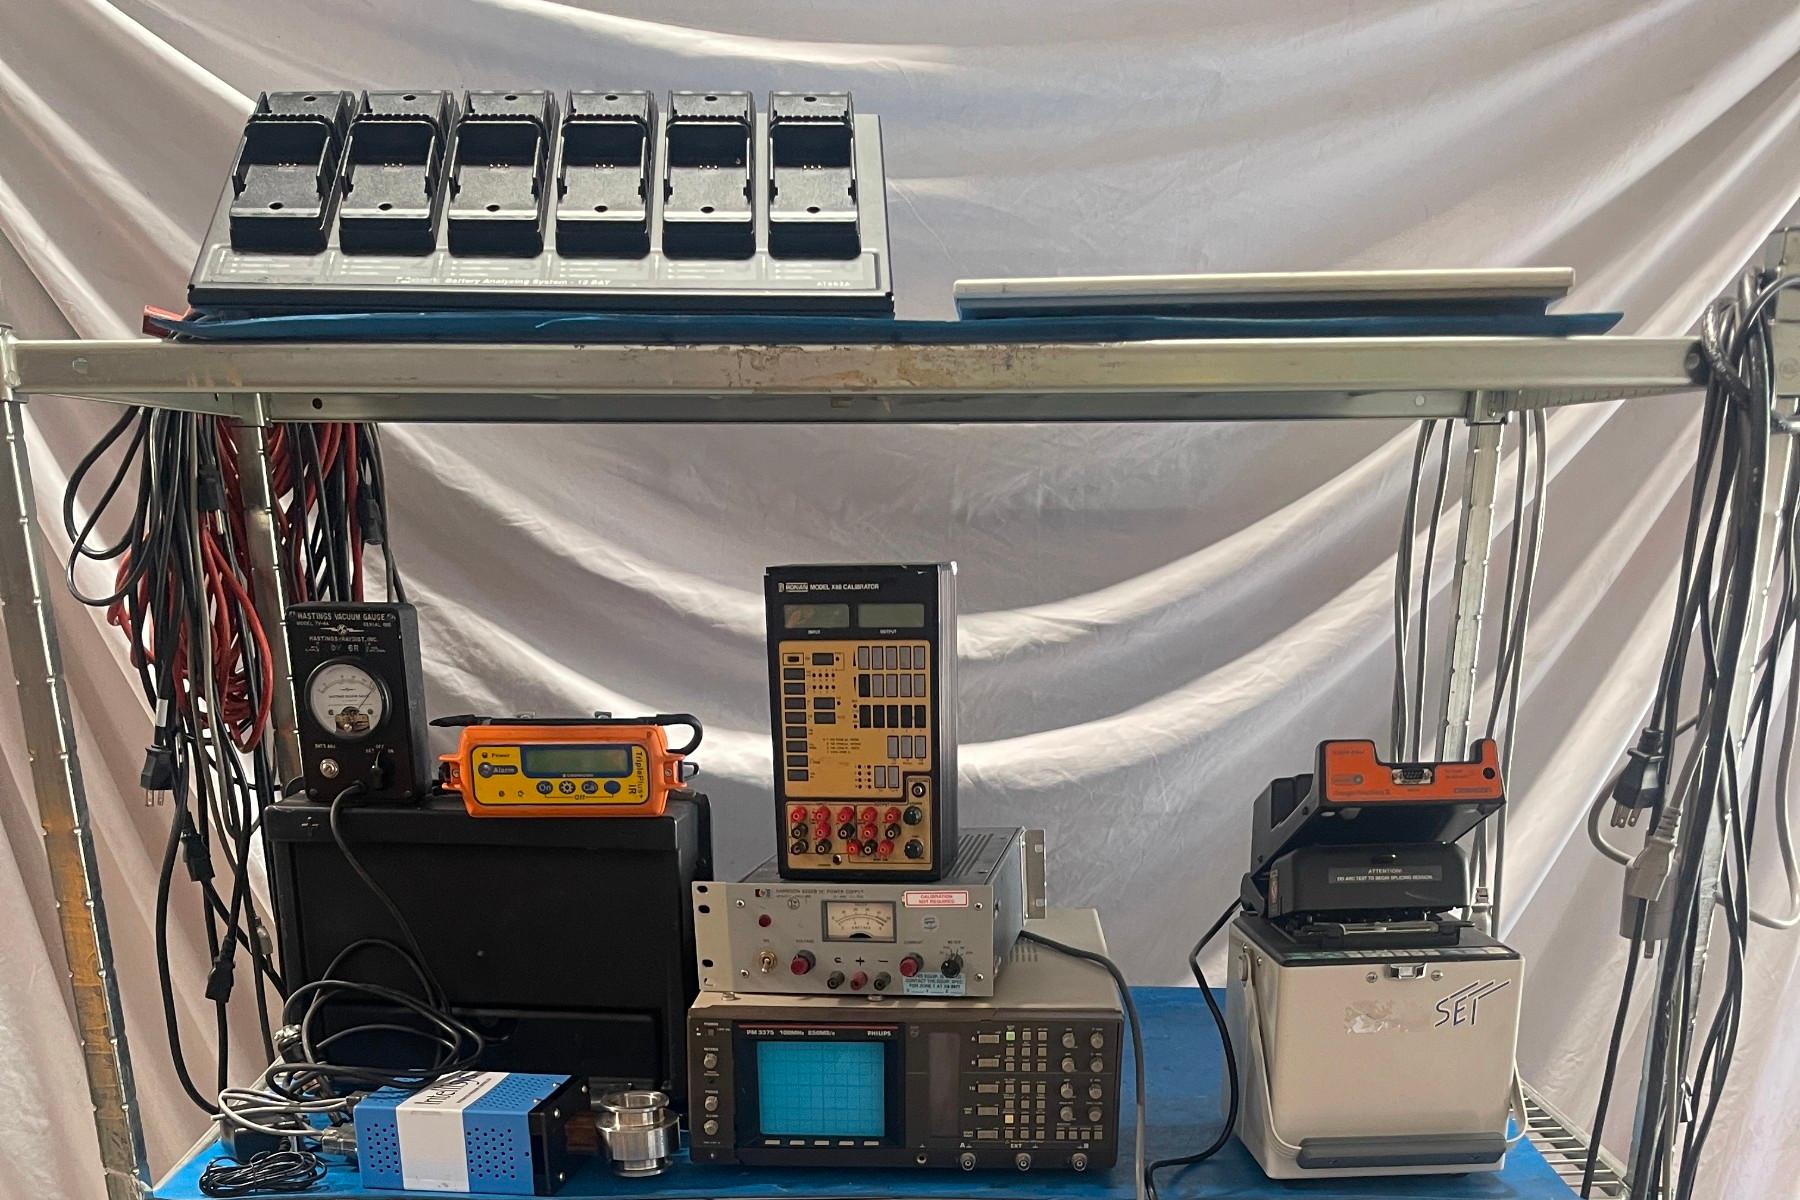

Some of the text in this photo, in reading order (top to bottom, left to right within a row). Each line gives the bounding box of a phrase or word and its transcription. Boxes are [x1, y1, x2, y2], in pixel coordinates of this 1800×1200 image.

[297, 613, 385, 621] HASTINGS VACUUM GAUGE
[539, 783, 551, 793] On
[1435, 981, 1511, 1027] SET
